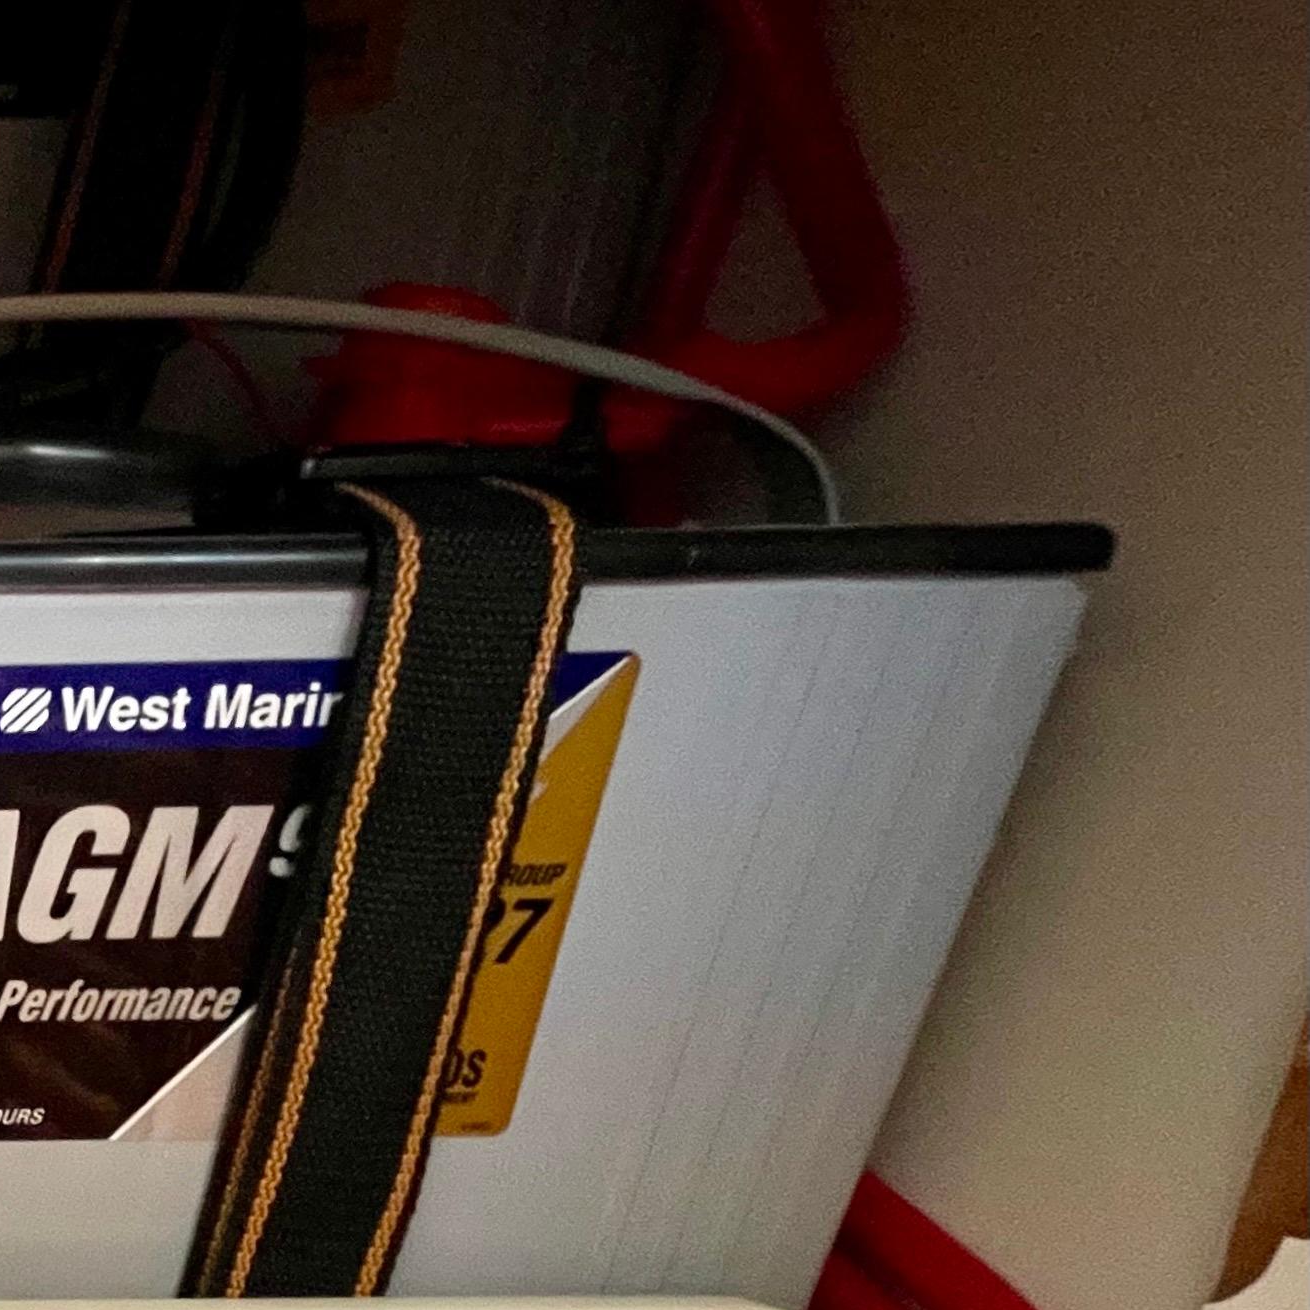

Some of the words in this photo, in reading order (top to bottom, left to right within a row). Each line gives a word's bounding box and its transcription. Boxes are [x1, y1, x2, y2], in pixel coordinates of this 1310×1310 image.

[61, 685, 192, 732] West
[204, 681, 343, 729] Marin
[500, 862, 568, 887] ROUP
[442, 1048, 488, 1090] OS
